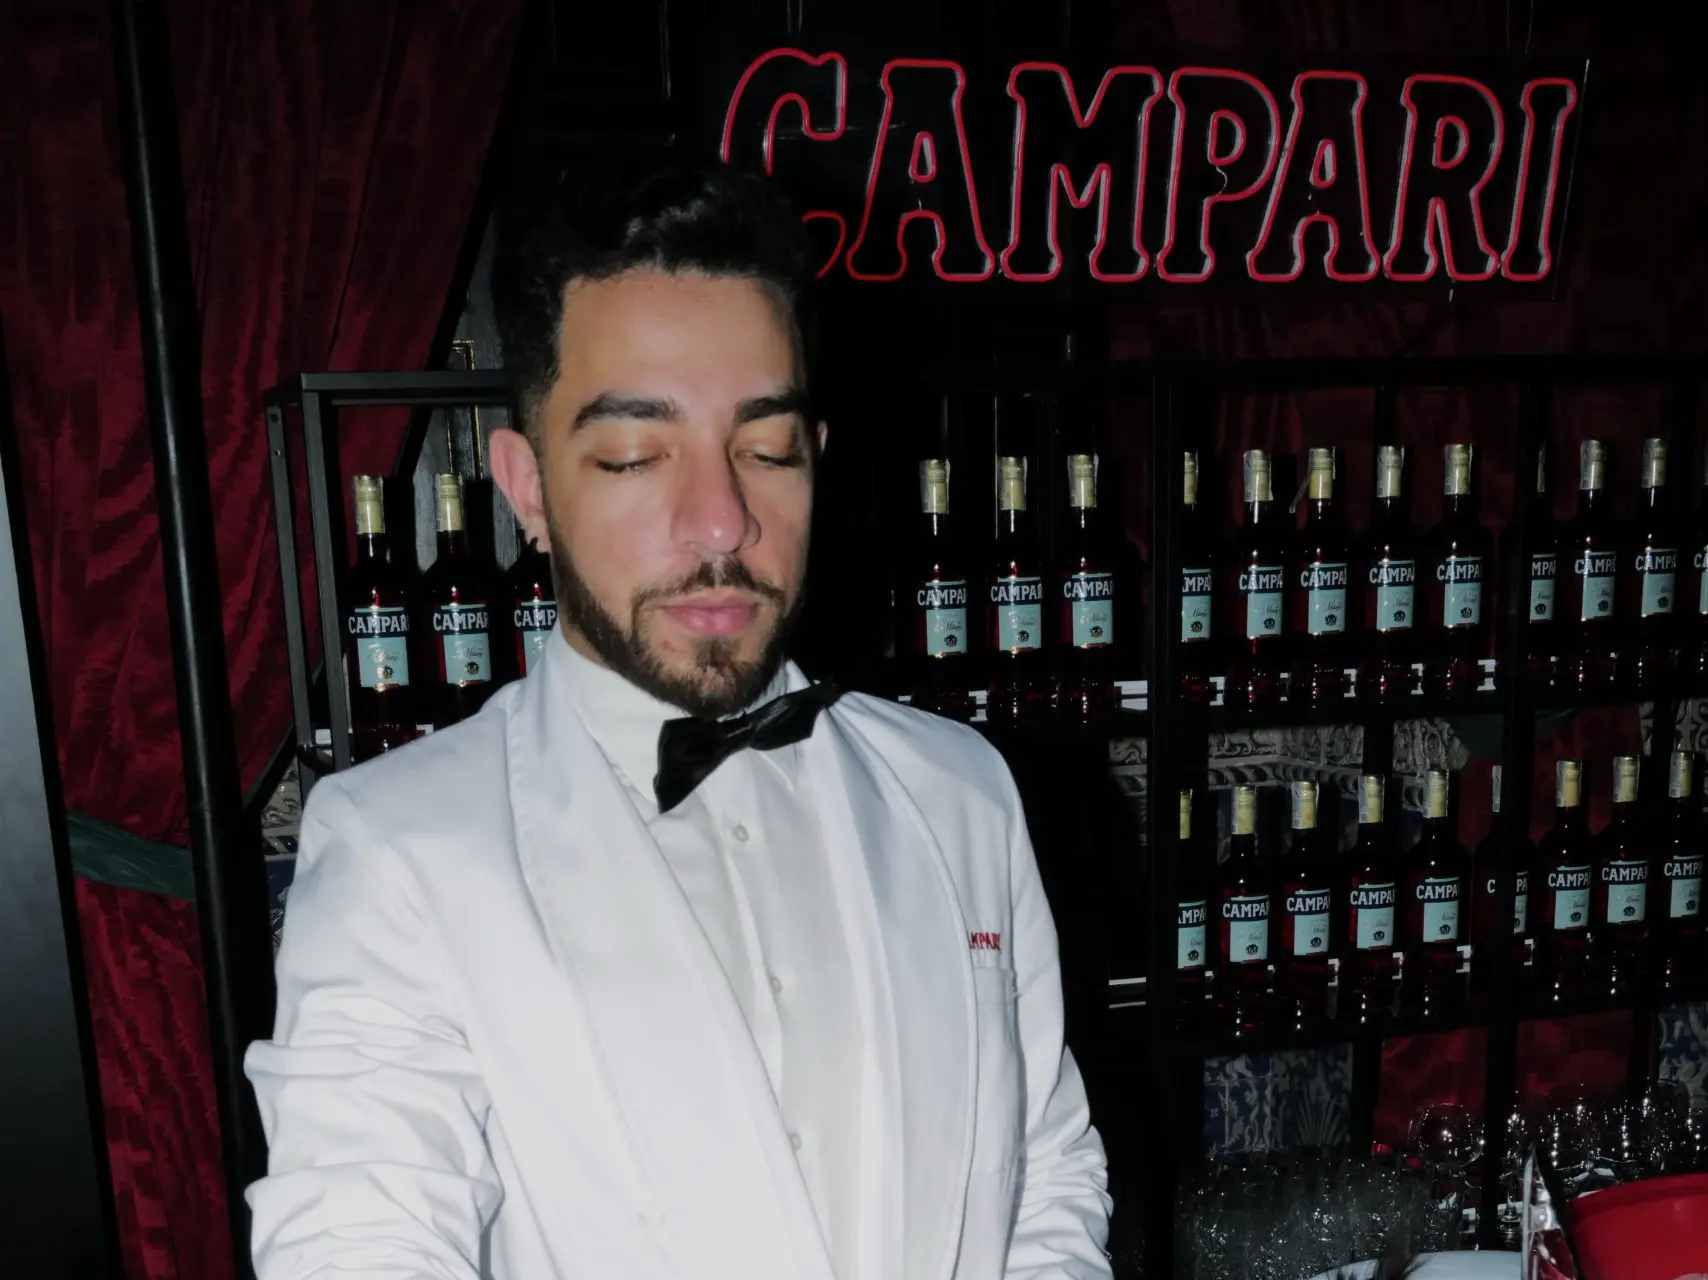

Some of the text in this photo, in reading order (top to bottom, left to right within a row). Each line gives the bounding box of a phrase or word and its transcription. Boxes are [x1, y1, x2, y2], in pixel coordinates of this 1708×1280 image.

[720, 48, 1576, 282] CAMPARI
[1300, 568, 1347, 587] CAMPA
[1369, 565, 1415, 584] CAMPA
[348, 614, 409, 634] CAMPAR
[1548, 871, 1591, 888] CAMPA
[1416, 884, 1460, 900] CAMPA
[1286, 895, 1331, 912] CAMPA
